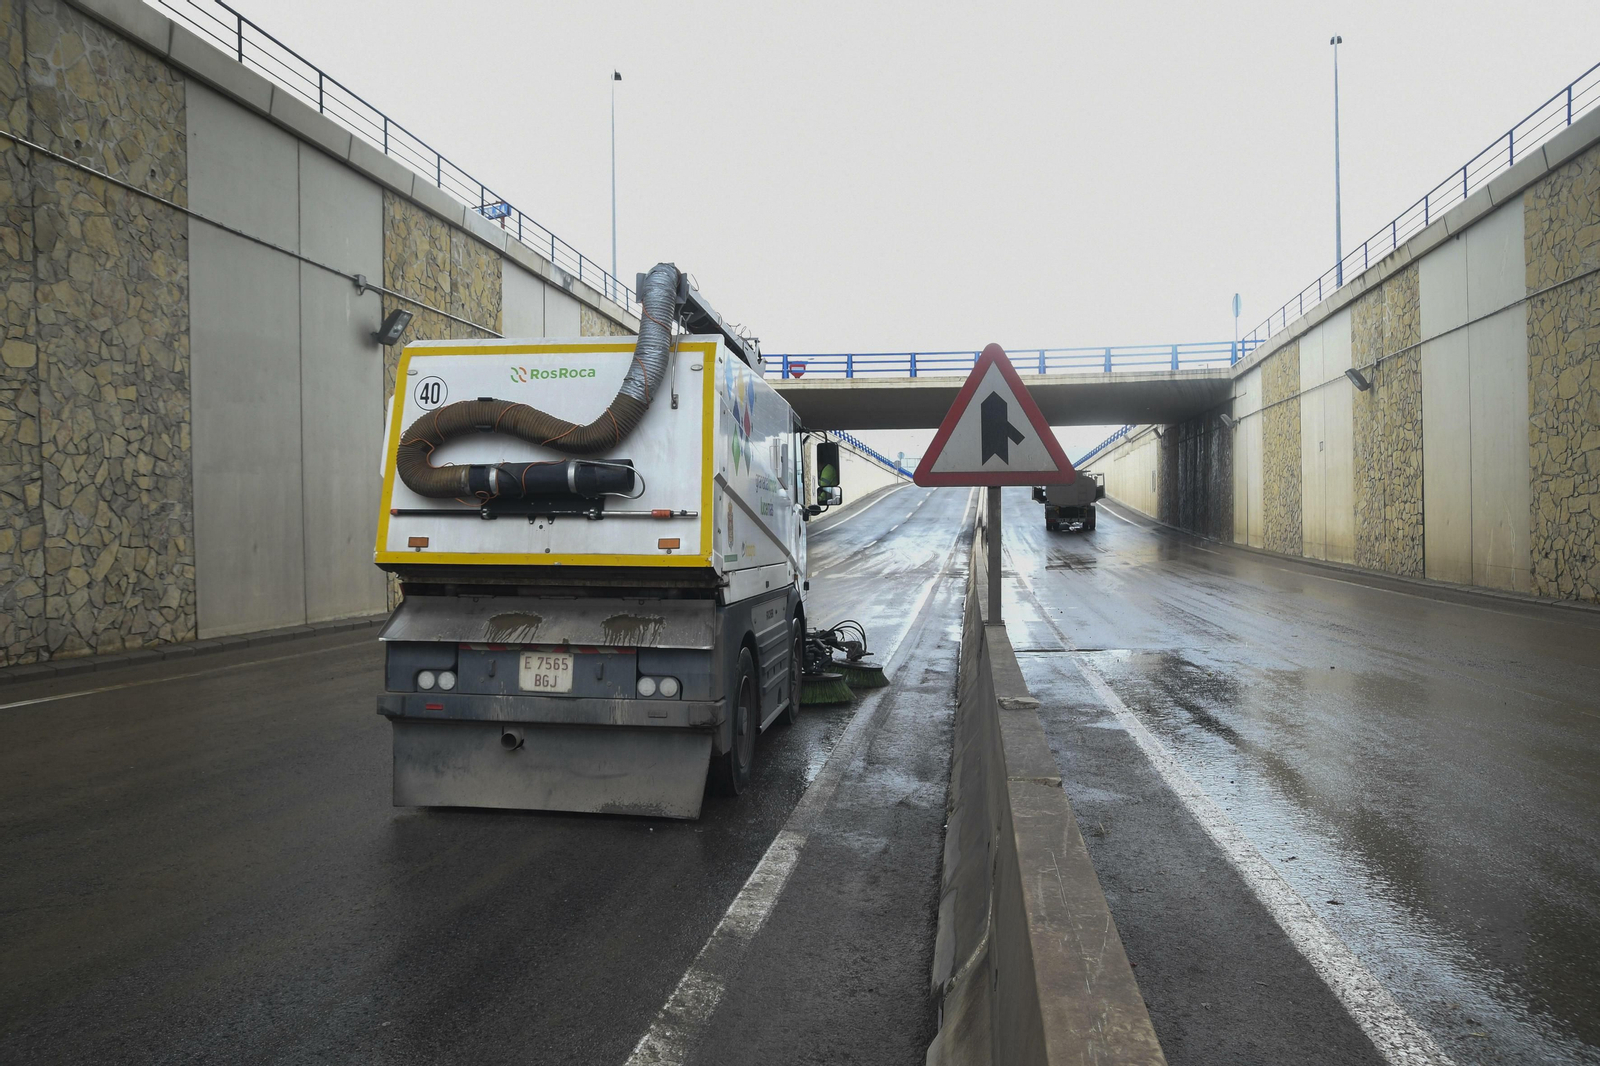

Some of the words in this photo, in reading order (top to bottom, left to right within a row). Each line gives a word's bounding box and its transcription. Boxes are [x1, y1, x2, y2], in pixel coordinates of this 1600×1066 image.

[530, 367, 596, 380] RosRoca
[420, 382, 440, 404] 40
[524, 656, 532, 669] E
[537, 656, 569, 670] 7565
[534, 673, 557, 688] BGJ
